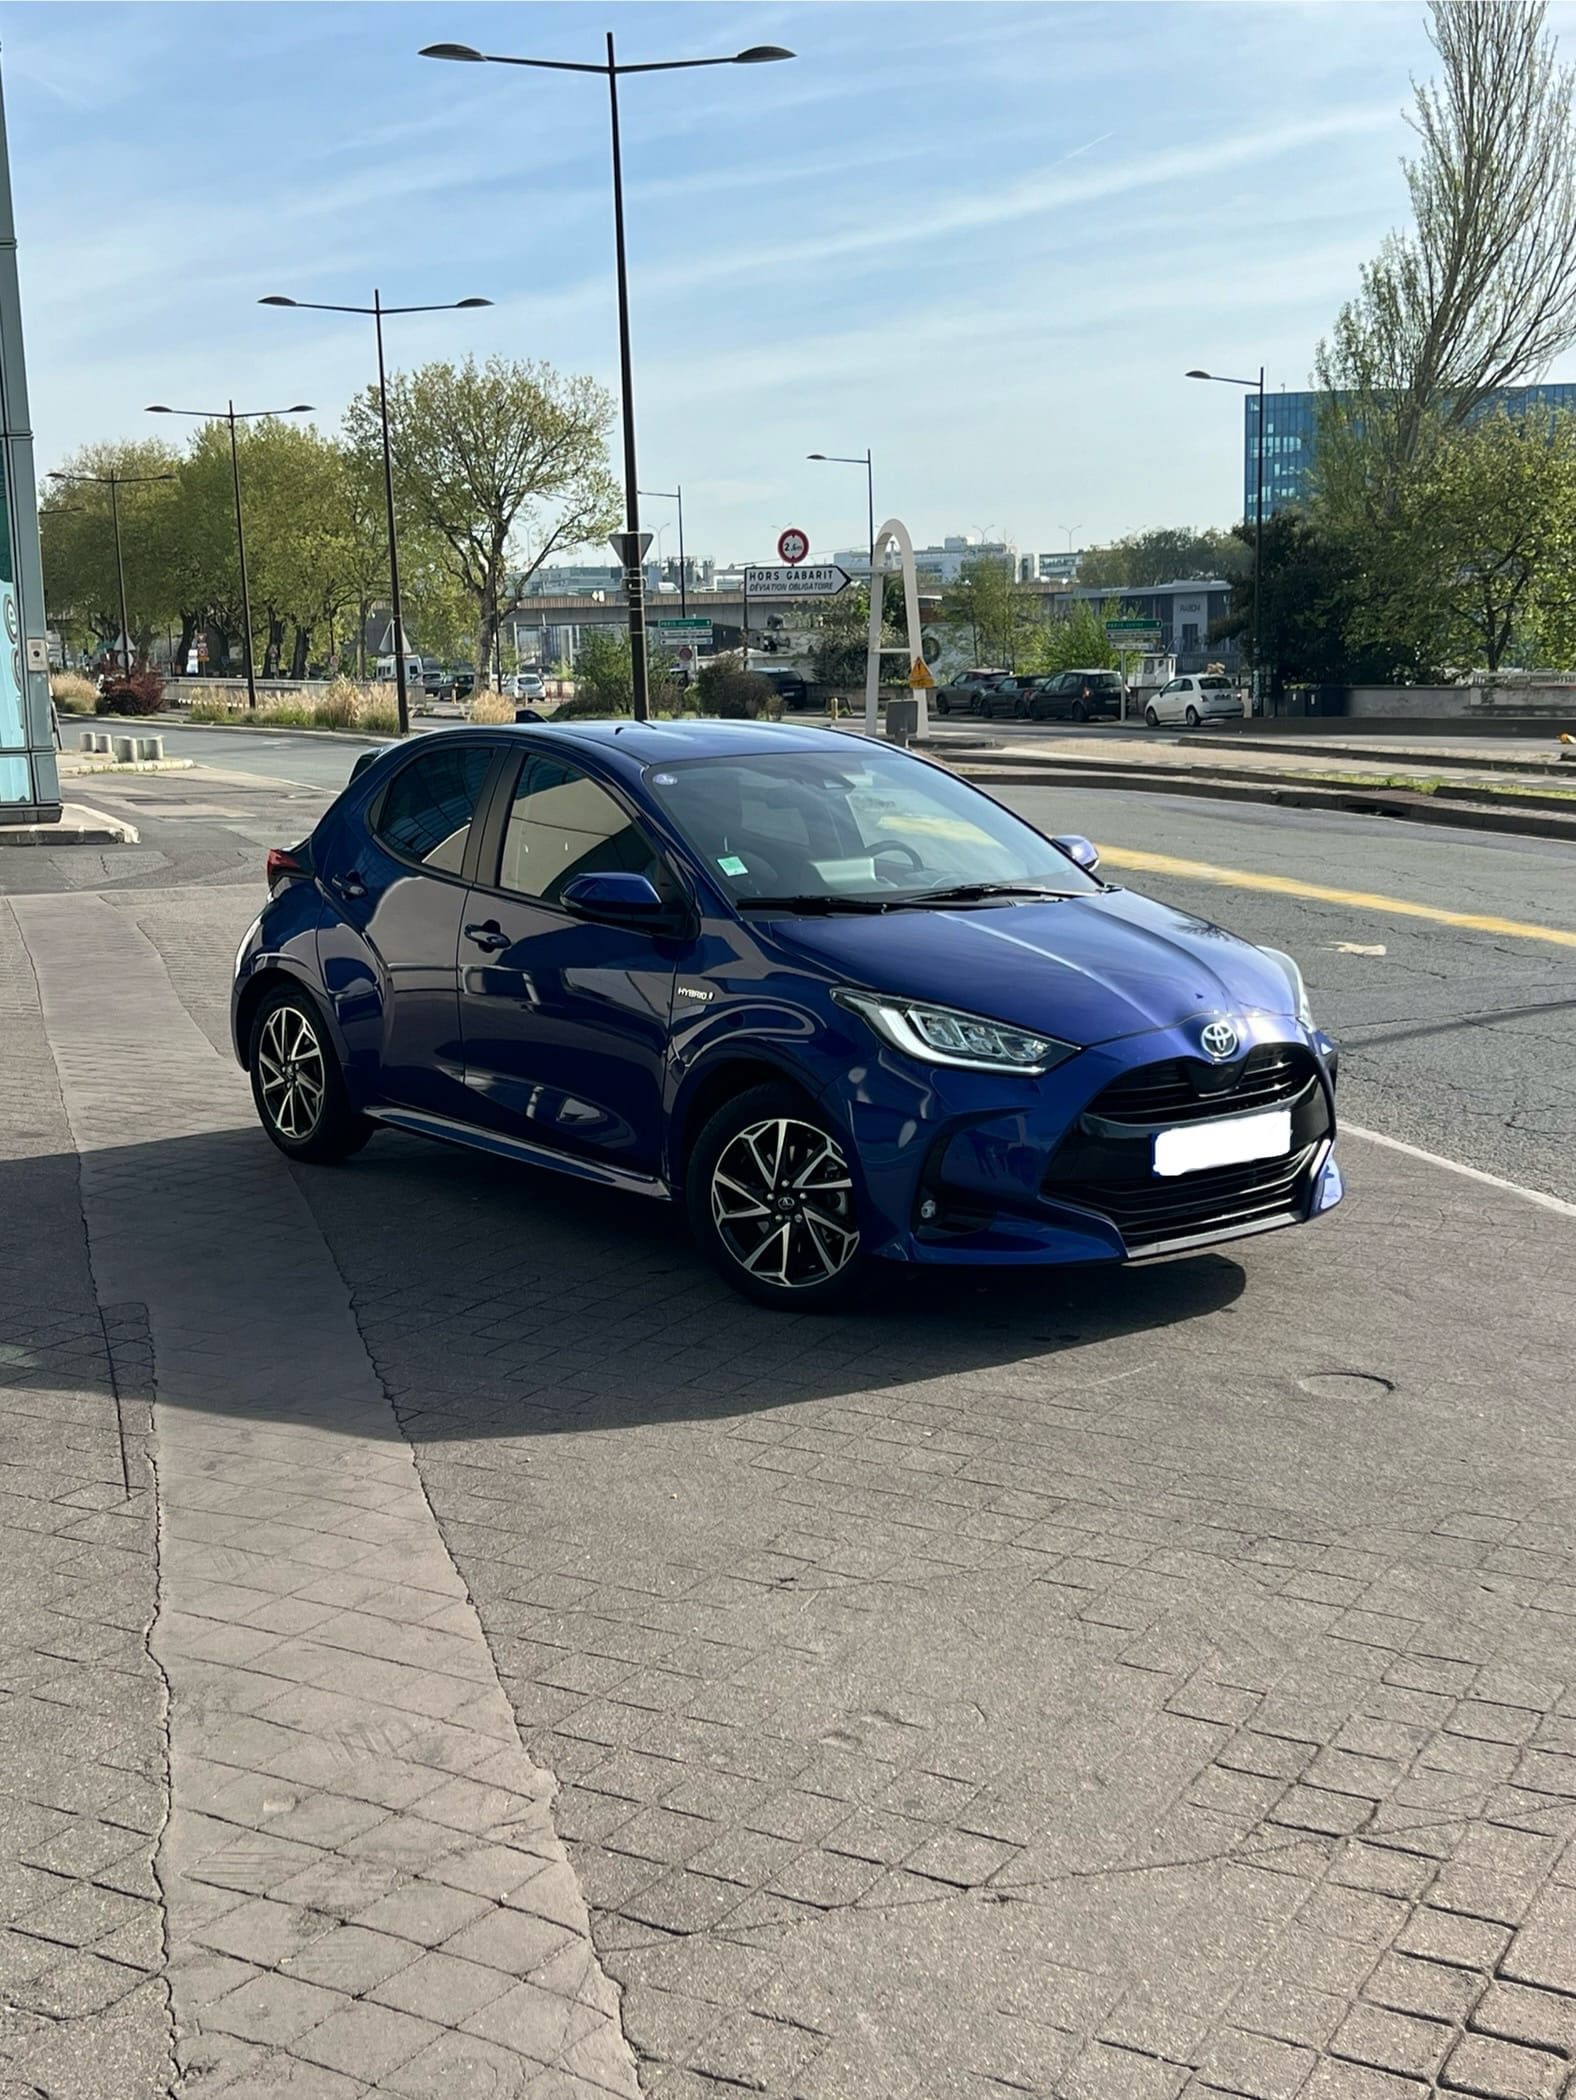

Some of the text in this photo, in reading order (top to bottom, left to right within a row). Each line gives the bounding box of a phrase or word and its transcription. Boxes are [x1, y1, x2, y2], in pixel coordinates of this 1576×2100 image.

[749, 570, 833, 581] HORS GABARIT
[749, 582, 787, 592] DÉVIATION
[678, 986, 707, 1000] HYBRID
